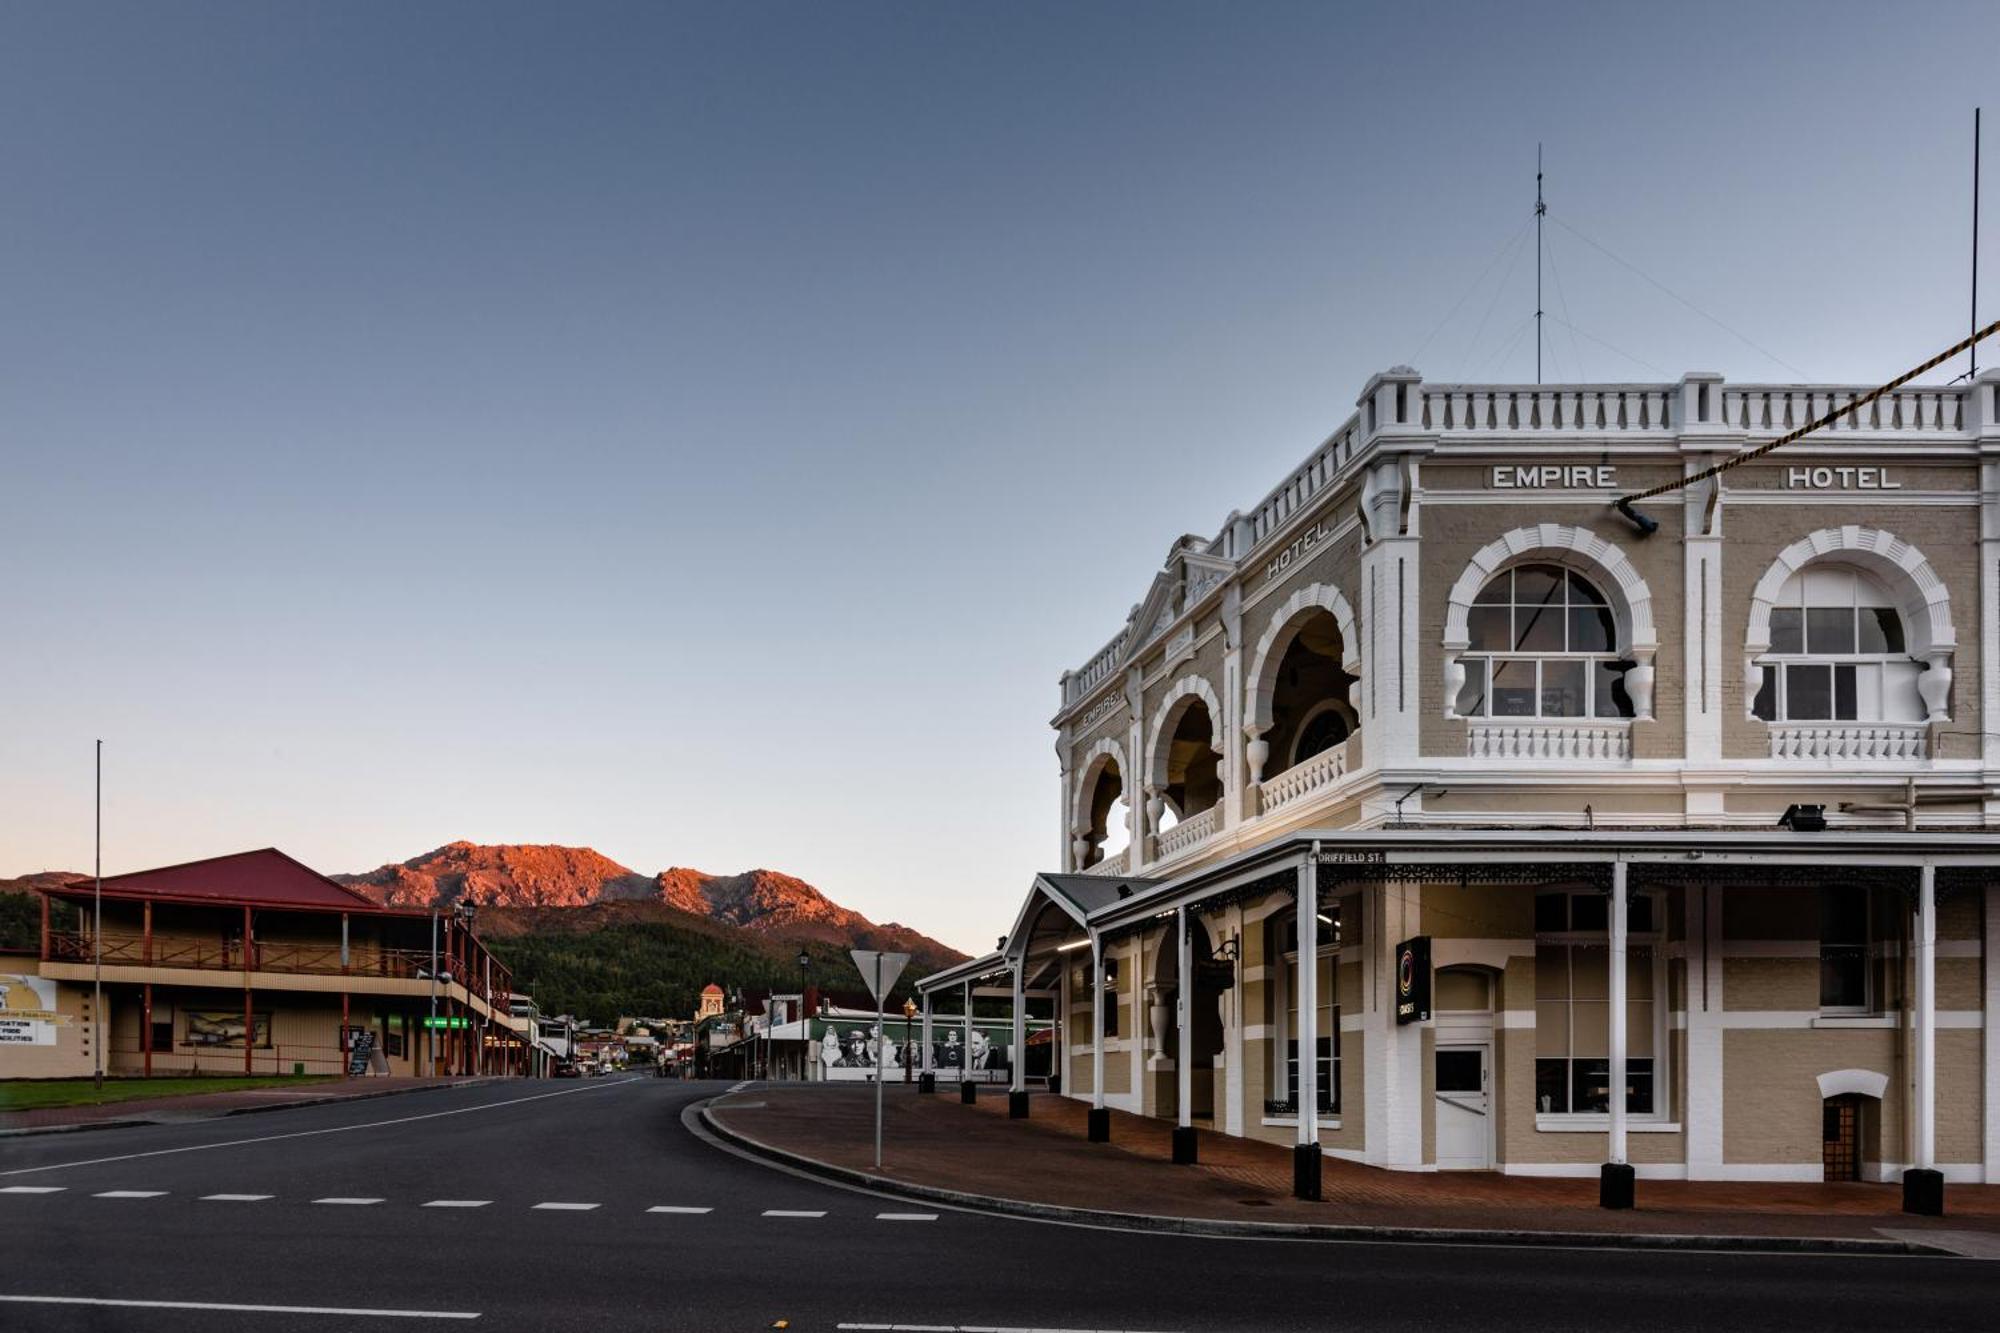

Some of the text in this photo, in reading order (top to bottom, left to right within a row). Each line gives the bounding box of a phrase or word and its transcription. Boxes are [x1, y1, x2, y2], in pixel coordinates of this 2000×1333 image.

[1493, 466, 1617, 488] EMPIRE
[1788, 467, 1901, 489] HOTEL
[1267, 523, 1329, 580] HOTEL
[1083, 690, 1119, 727] EMPIRE
